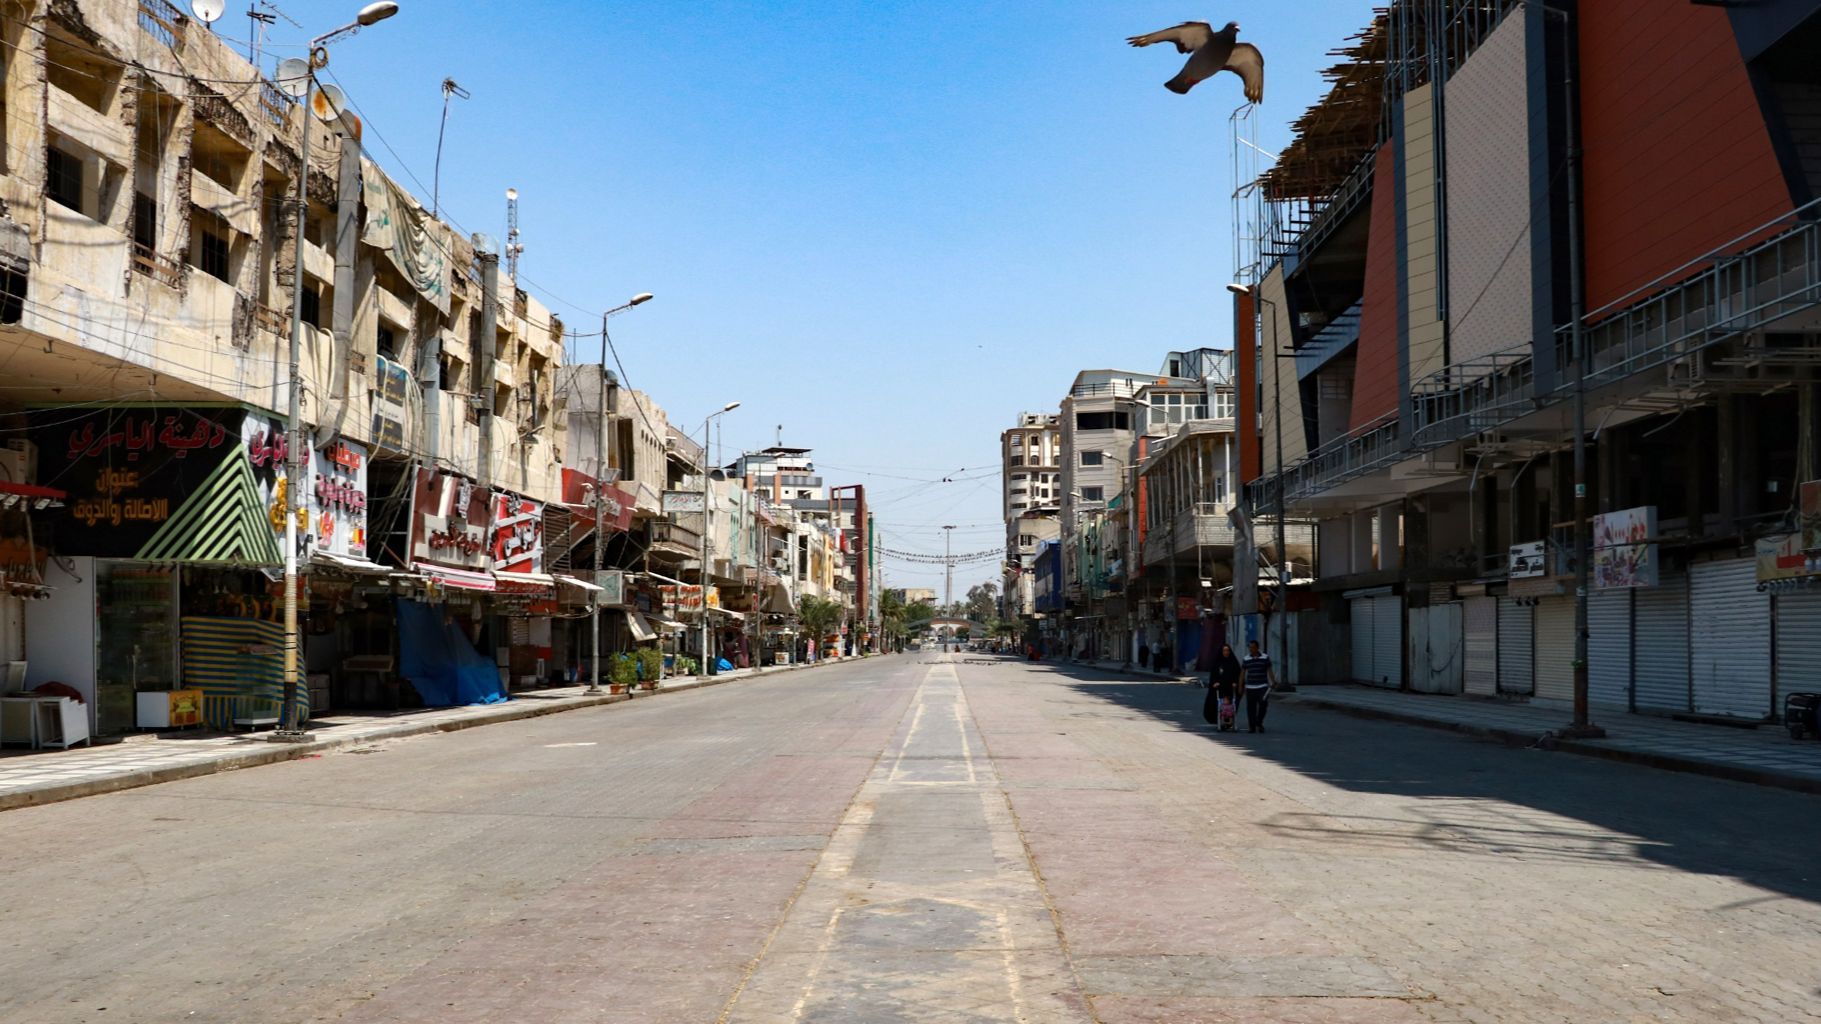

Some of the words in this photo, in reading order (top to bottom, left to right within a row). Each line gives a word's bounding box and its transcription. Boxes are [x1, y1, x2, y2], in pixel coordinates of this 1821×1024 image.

[66, 416, 155, 461] الياسري
[158, 416, 225, 459] دهينة
[95, 466, 140, 495] عنوان
[123, 497, 168, 523] الاصالة
